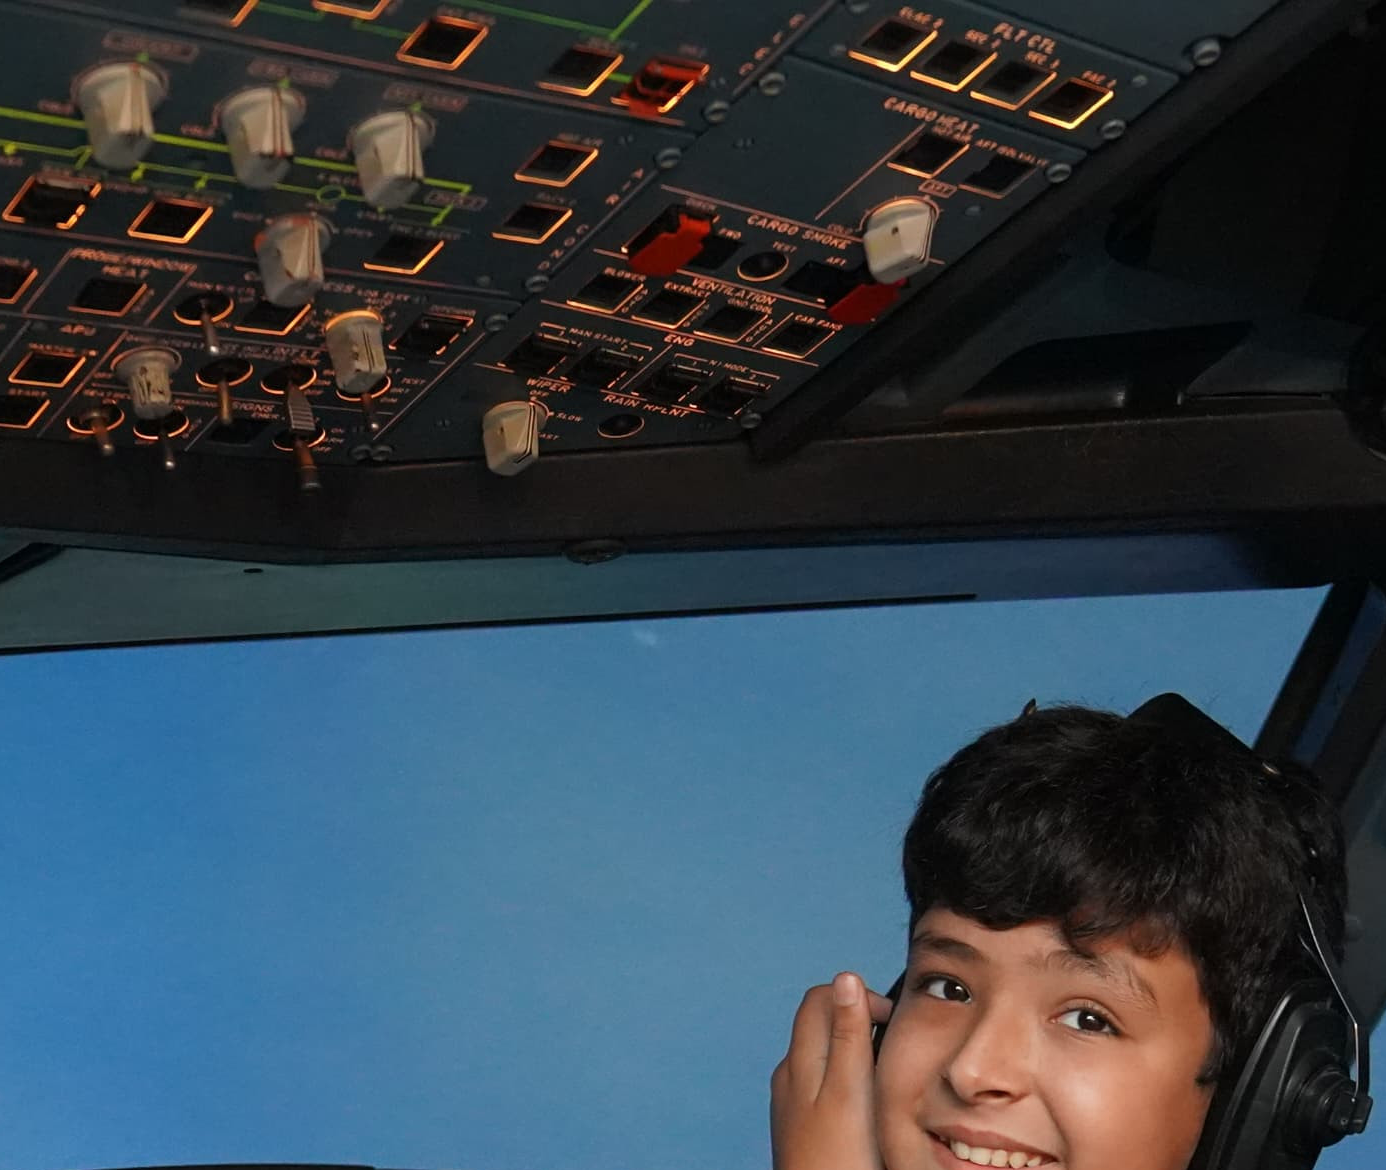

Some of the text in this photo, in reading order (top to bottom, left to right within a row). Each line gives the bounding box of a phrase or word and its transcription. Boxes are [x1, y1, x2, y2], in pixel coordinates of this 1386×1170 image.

[992, 22, 1057, 55] FLT CTL
[882, 96, 981, 135] CARGO HEAT
[746, 214, 853, 250] CARGO SMOKE
[824, 255, 849, 267] AFT
[602, 266, 648, 282] BLOWER
[663, 281, 712, 299] EXTRACT
[691, 278, 778, 305] VENTILATION
[569, 327, 627, 346] MAN START
[663, 335, 696, 347] ENG
[526, 377, 573, 394] WIPER
[602, 394, 640, 409] RAIN
